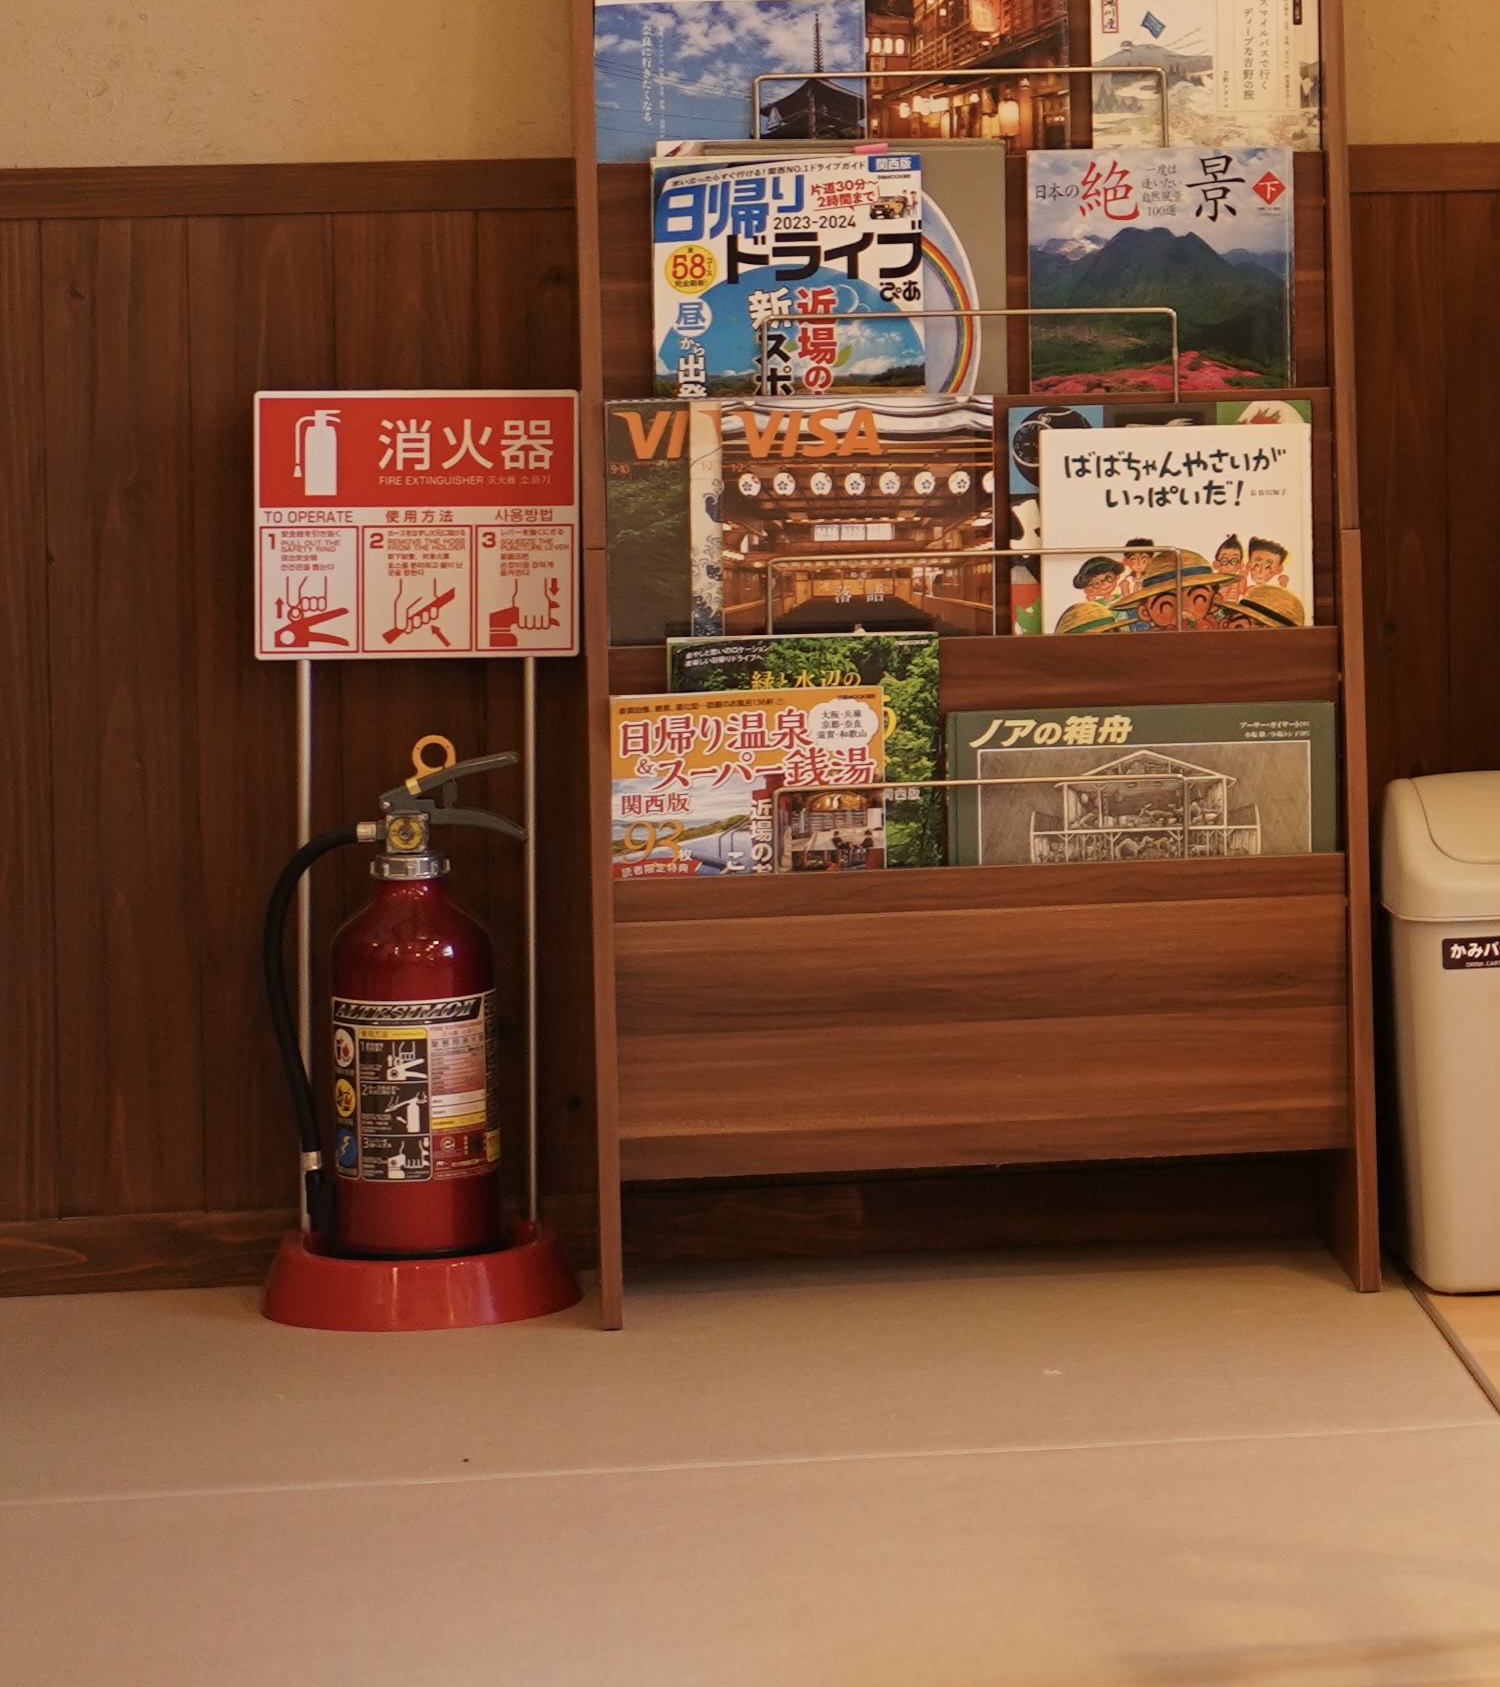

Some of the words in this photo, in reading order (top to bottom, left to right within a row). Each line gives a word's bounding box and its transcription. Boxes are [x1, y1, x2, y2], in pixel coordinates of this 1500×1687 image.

[1242, 8, 1255, 101] ディープな吉野の旅
[1259, 0, 1271, 90] スマイルバスで行く
[875, 157, 912, 170] 関西版
[1146, 164, 1177, 176] 一度は
[1034, 184, 1079, 201] 日本の
[1078, 160, 1140, 221] 絶
[1185, 154, 1245, 223] 景
[1258, 181, 1279, 197] 下
[655, 174, 805, 243] 日帰り
[817, 191, 876, 208] 2時間まで
[773, 215, 856, 230] 2023-2024
[727, 220, 922, 284] ドライブ
[672, 254, 706, 279] 58
[879, 280, 921, 302] ぴあ
[733, 409, 882, 458] VISA
[378, 418, 555, 471] 消火器
[1063, 447, 1287, 481] ばばちゃんやさいが
[378, 476, 402, 485] FIRE
[405, 476, 484, 485] EXTINGUISHER
[264, 511, 285, 523] TO
[288, 511, 353, 523] OPERATE
[385, 509, 454, 523] 使用方法
[495, 508, 553, 522] 사용방법
[268, 534, 276, 549] 1
[370, 532, 384, 549] 2
[482, 532, 496, 548] 3
[822, 710, 862, 720] 大阪・兵庫
[822, 720, 863, 729] 京都・奈良
[619, 708, 814, 756] 日帰り温泉
[969, 715, 1133, 748] ノアの箱舟
[637, 746, 875, 789] &スーパー銭湯
[621, 794, 691, 815] 関西版
[623, 820, 685, 864] 93
